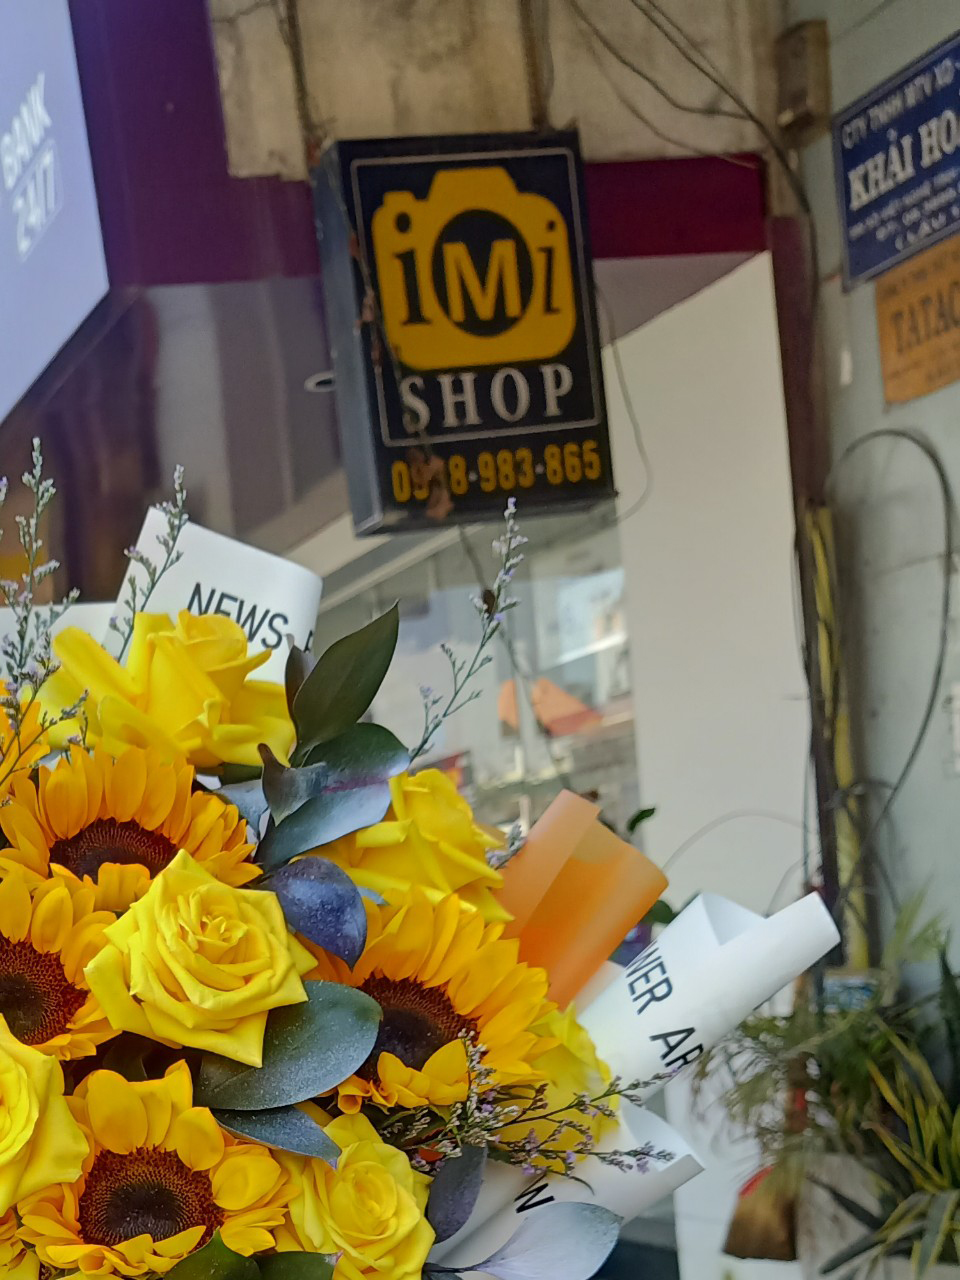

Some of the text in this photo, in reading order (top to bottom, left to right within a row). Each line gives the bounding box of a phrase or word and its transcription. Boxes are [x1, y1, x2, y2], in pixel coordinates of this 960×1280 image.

[847, 127, 917, 213] KHẢI
[917, 108, 960, 170] HO
[398, 362, 574, 434] SHOP
